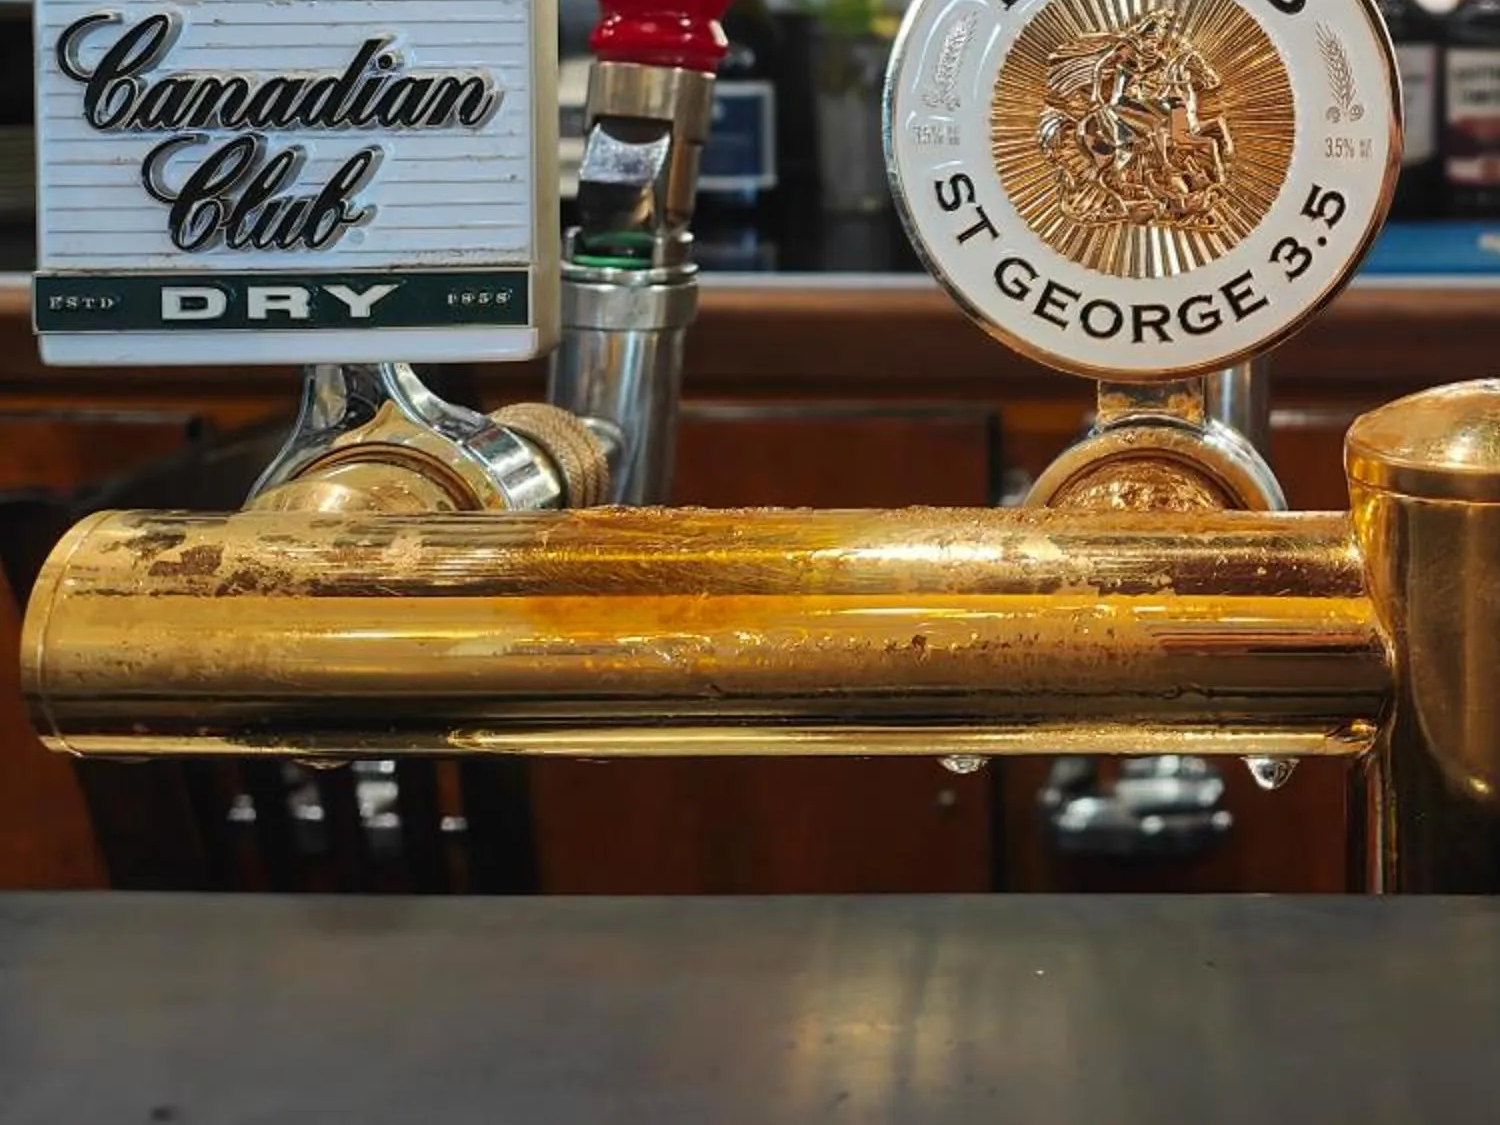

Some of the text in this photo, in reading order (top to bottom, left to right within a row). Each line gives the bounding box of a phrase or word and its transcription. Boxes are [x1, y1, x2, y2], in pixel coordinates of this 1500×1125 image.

[56, 10, 504, 133] Canadian
[142, 132, 384, 252] Club
[161, 284, 400, 320] DRY
[935, 172, 1346, 344] ST GEORGE 3.5
